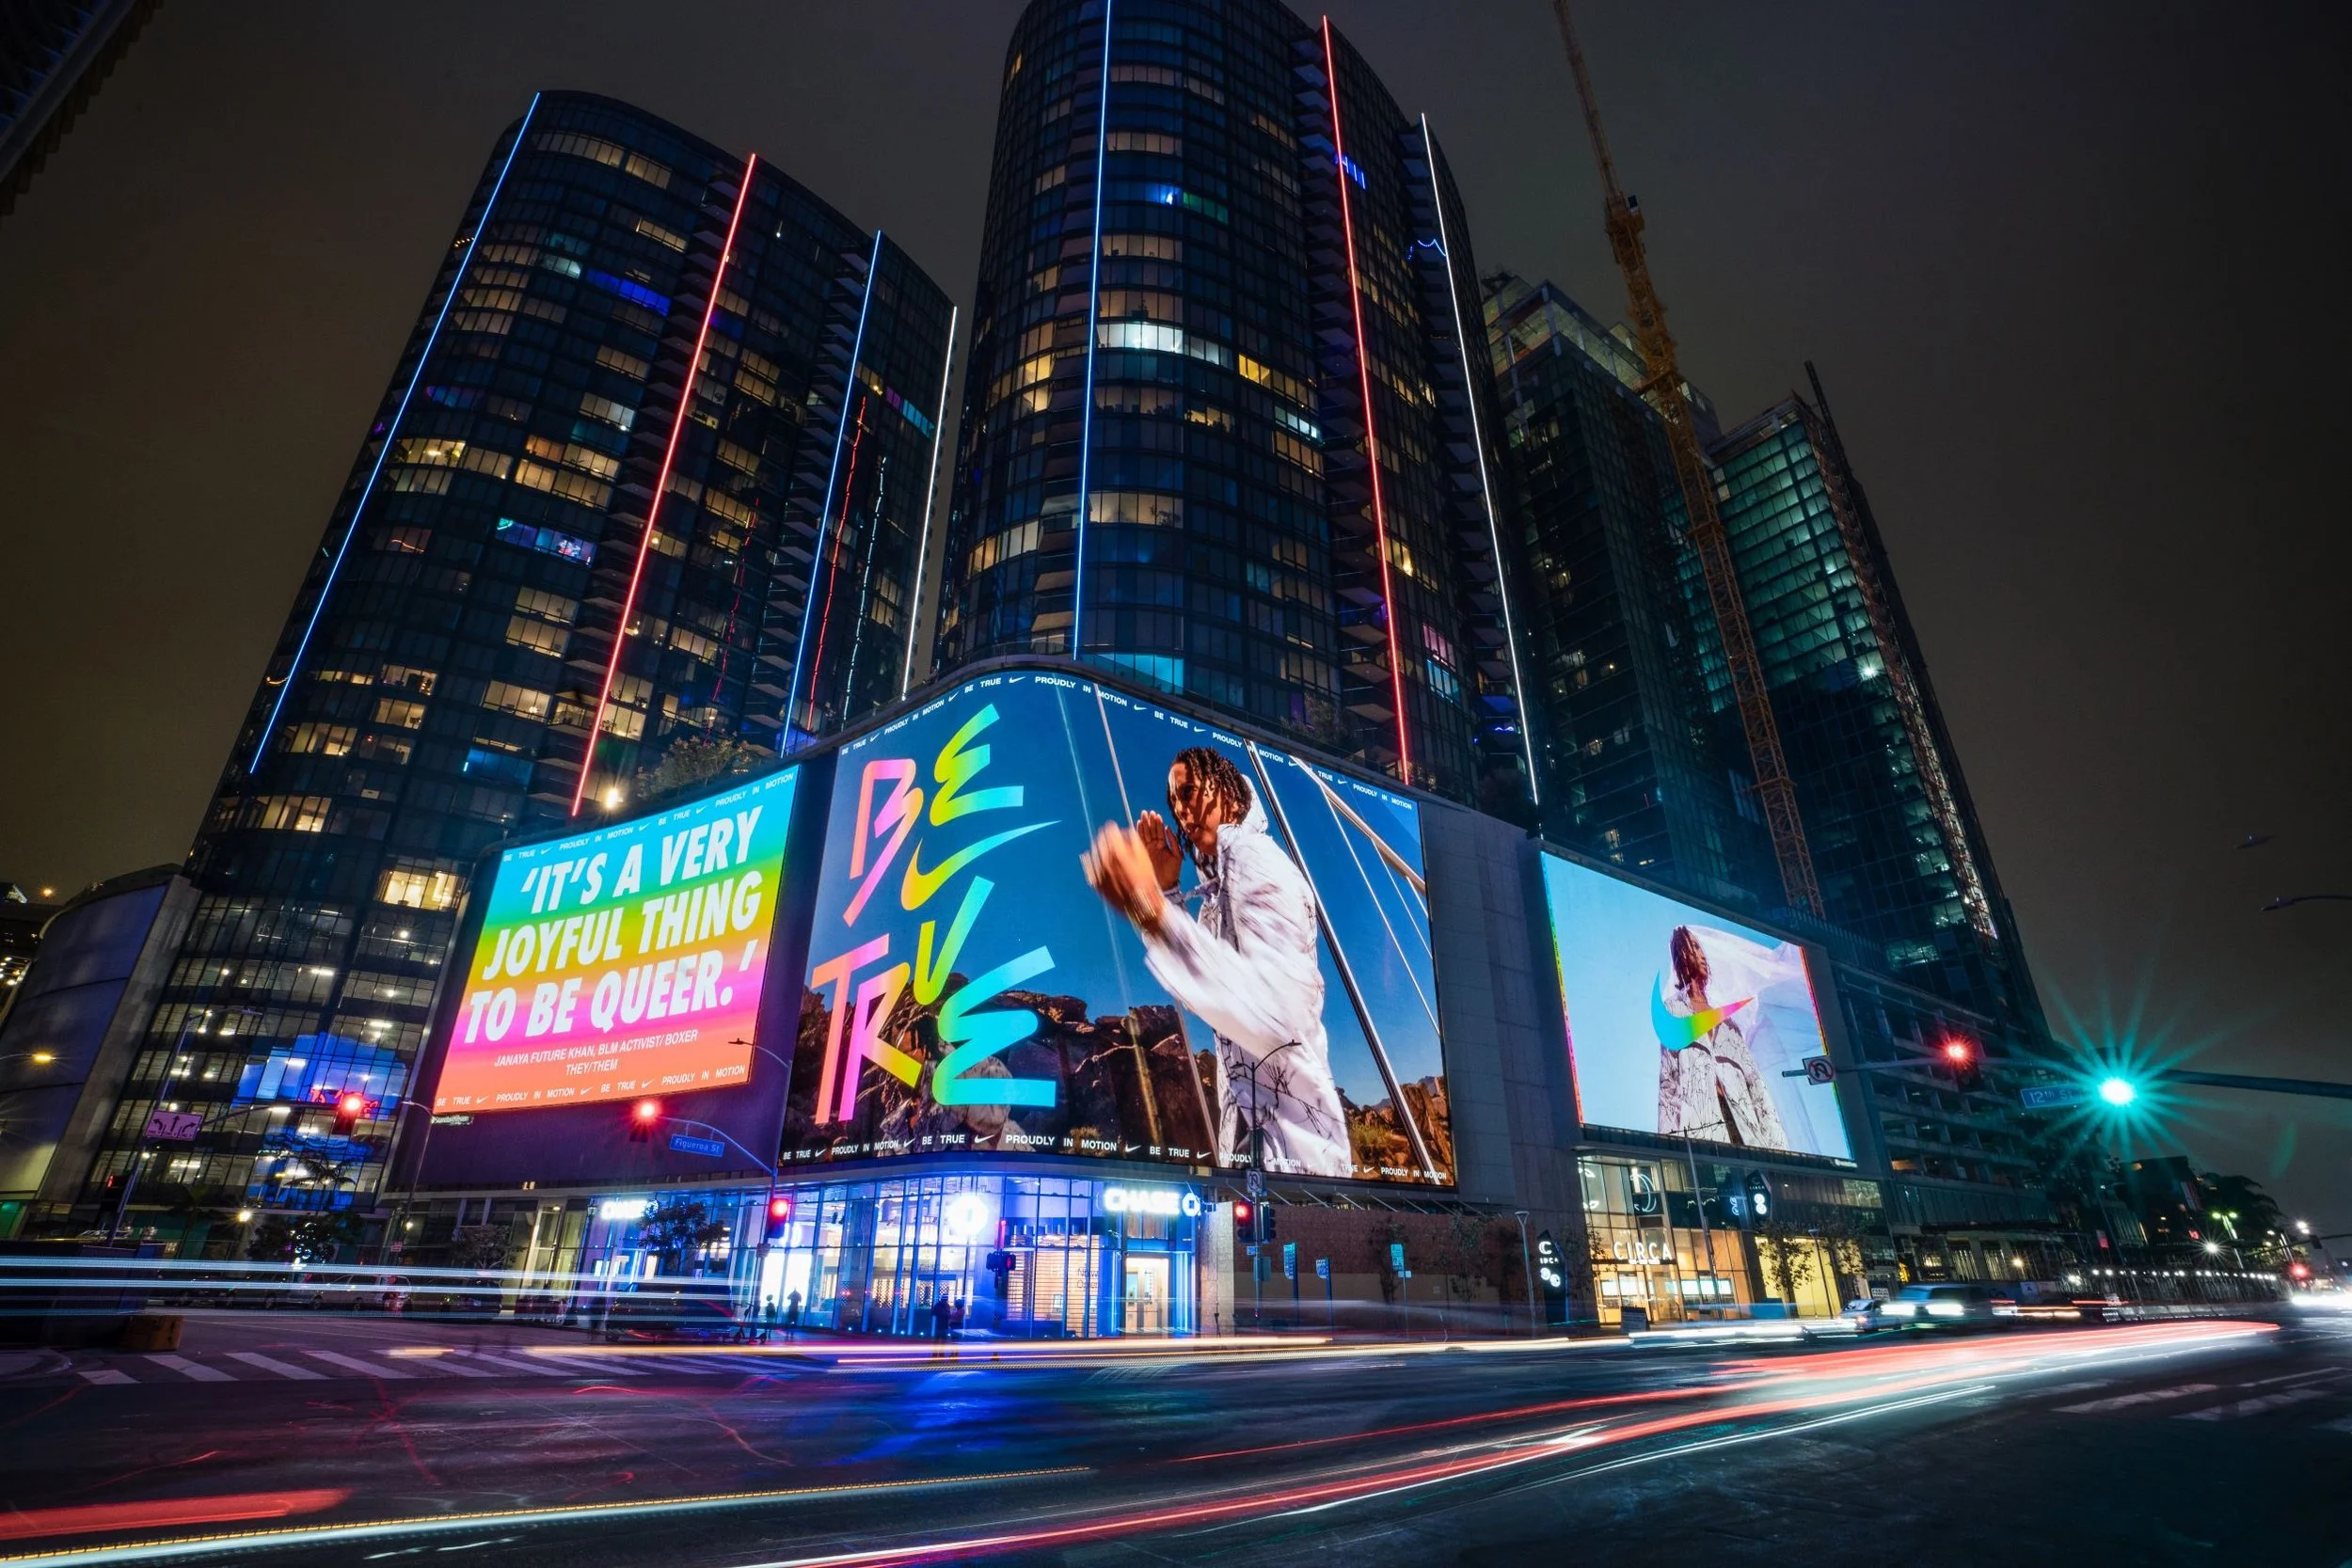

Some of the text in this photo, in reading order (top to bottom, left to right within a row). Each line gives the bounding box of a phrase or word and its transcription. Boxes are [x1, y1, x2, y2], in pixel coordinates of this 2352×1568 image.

[852, 739, 866, 750] TRUE
[884, 719, 909, 735] PROUDLY
[922, 700, 945, 716] MOTION
[964, 685, 974, 693] BE
[980, 677, 1001, 688] TRUE
[1035, 676, 1076, 689] PROUDLY
[1083, 685, 1091, 693] IN
[1097, 690, 1127, 706] MOTION
[1154, 711, 1164, 720] BE
[1169, 717, 1188, 729] TRUE
[1212, 732, 1242, 748] PROUDLY
[1259, 749, 1284, 764] MOTION
[1318, 770, 1333, 782] TRUE
[1353, 784, 1378, 798] PROUDLY
[1391, 798, 1412, 810] MOTION
[559, 838, 590, 850] PROUDLY
[607, 827, 633, 839] MOTION
[674, 809, 691, 820] TRUE
[715, 790, 747, 807] PROUDLY
[765, 772, 794, 790] MOTION
[612, 843, 643, 898] A
[660, 805, 763, 887] VERY
[482, 870, 763, 981] JOYFUL THING
[464, 988, 518, 1044] TO
[525, 977, 585, 1037] BE
[494, 1053, 529, 1068] JANAYA
[530, 1048, 566, 1063] FUTURE
[567, 1045, 596, 1058] KHAN,
[598, 1040, 619, 1054] BLM
[565, 1058, 618, 1075] THEY/THEM
[453, 1095, 471, 1106] TRUE
[496, 1091, 529, 1102] PROUDLY
[533, 1090, 542, 1099] IN
[546, 1087, 576, 1099] MOTION
[600, 1084, 611, 1093] BE
[617, 1081, 636, 1090] TRUE
[661, 1072, 696, 1085] PROUDLY
[701, 1070, 710, 1080] IN
[715, 1065, 746, 1078] MOTION
[711, 1142, 720, 1152] St
[783, 1151, 791, 1160] BE
[796, 1149, 811, 1159] TRUE
[831, 1144, 859, 1155] PROUDLY
[863, 1143, 870, 1151] IN
[874, 1140, 898, 1150] MOTION
[922, 1136, 932, 1145] BE
[940, 1134, 965, 1144] TRUE
[1006, 1134, 1055, 1146] PROUDLY
[1063, 1138, 1073, 1148] IN
[1081, 1139, 1117, 1152] MOTION
[1150, 1146, 1161, 1155] BE
[1168, 1148, 1190, 1158] TRUE
[1381, 1166, 1408, 1177] PROUDLY
[1104, 1187, 1180, 1215] CHASE
[1613, 1241, 1673, 1260] CIRCA
